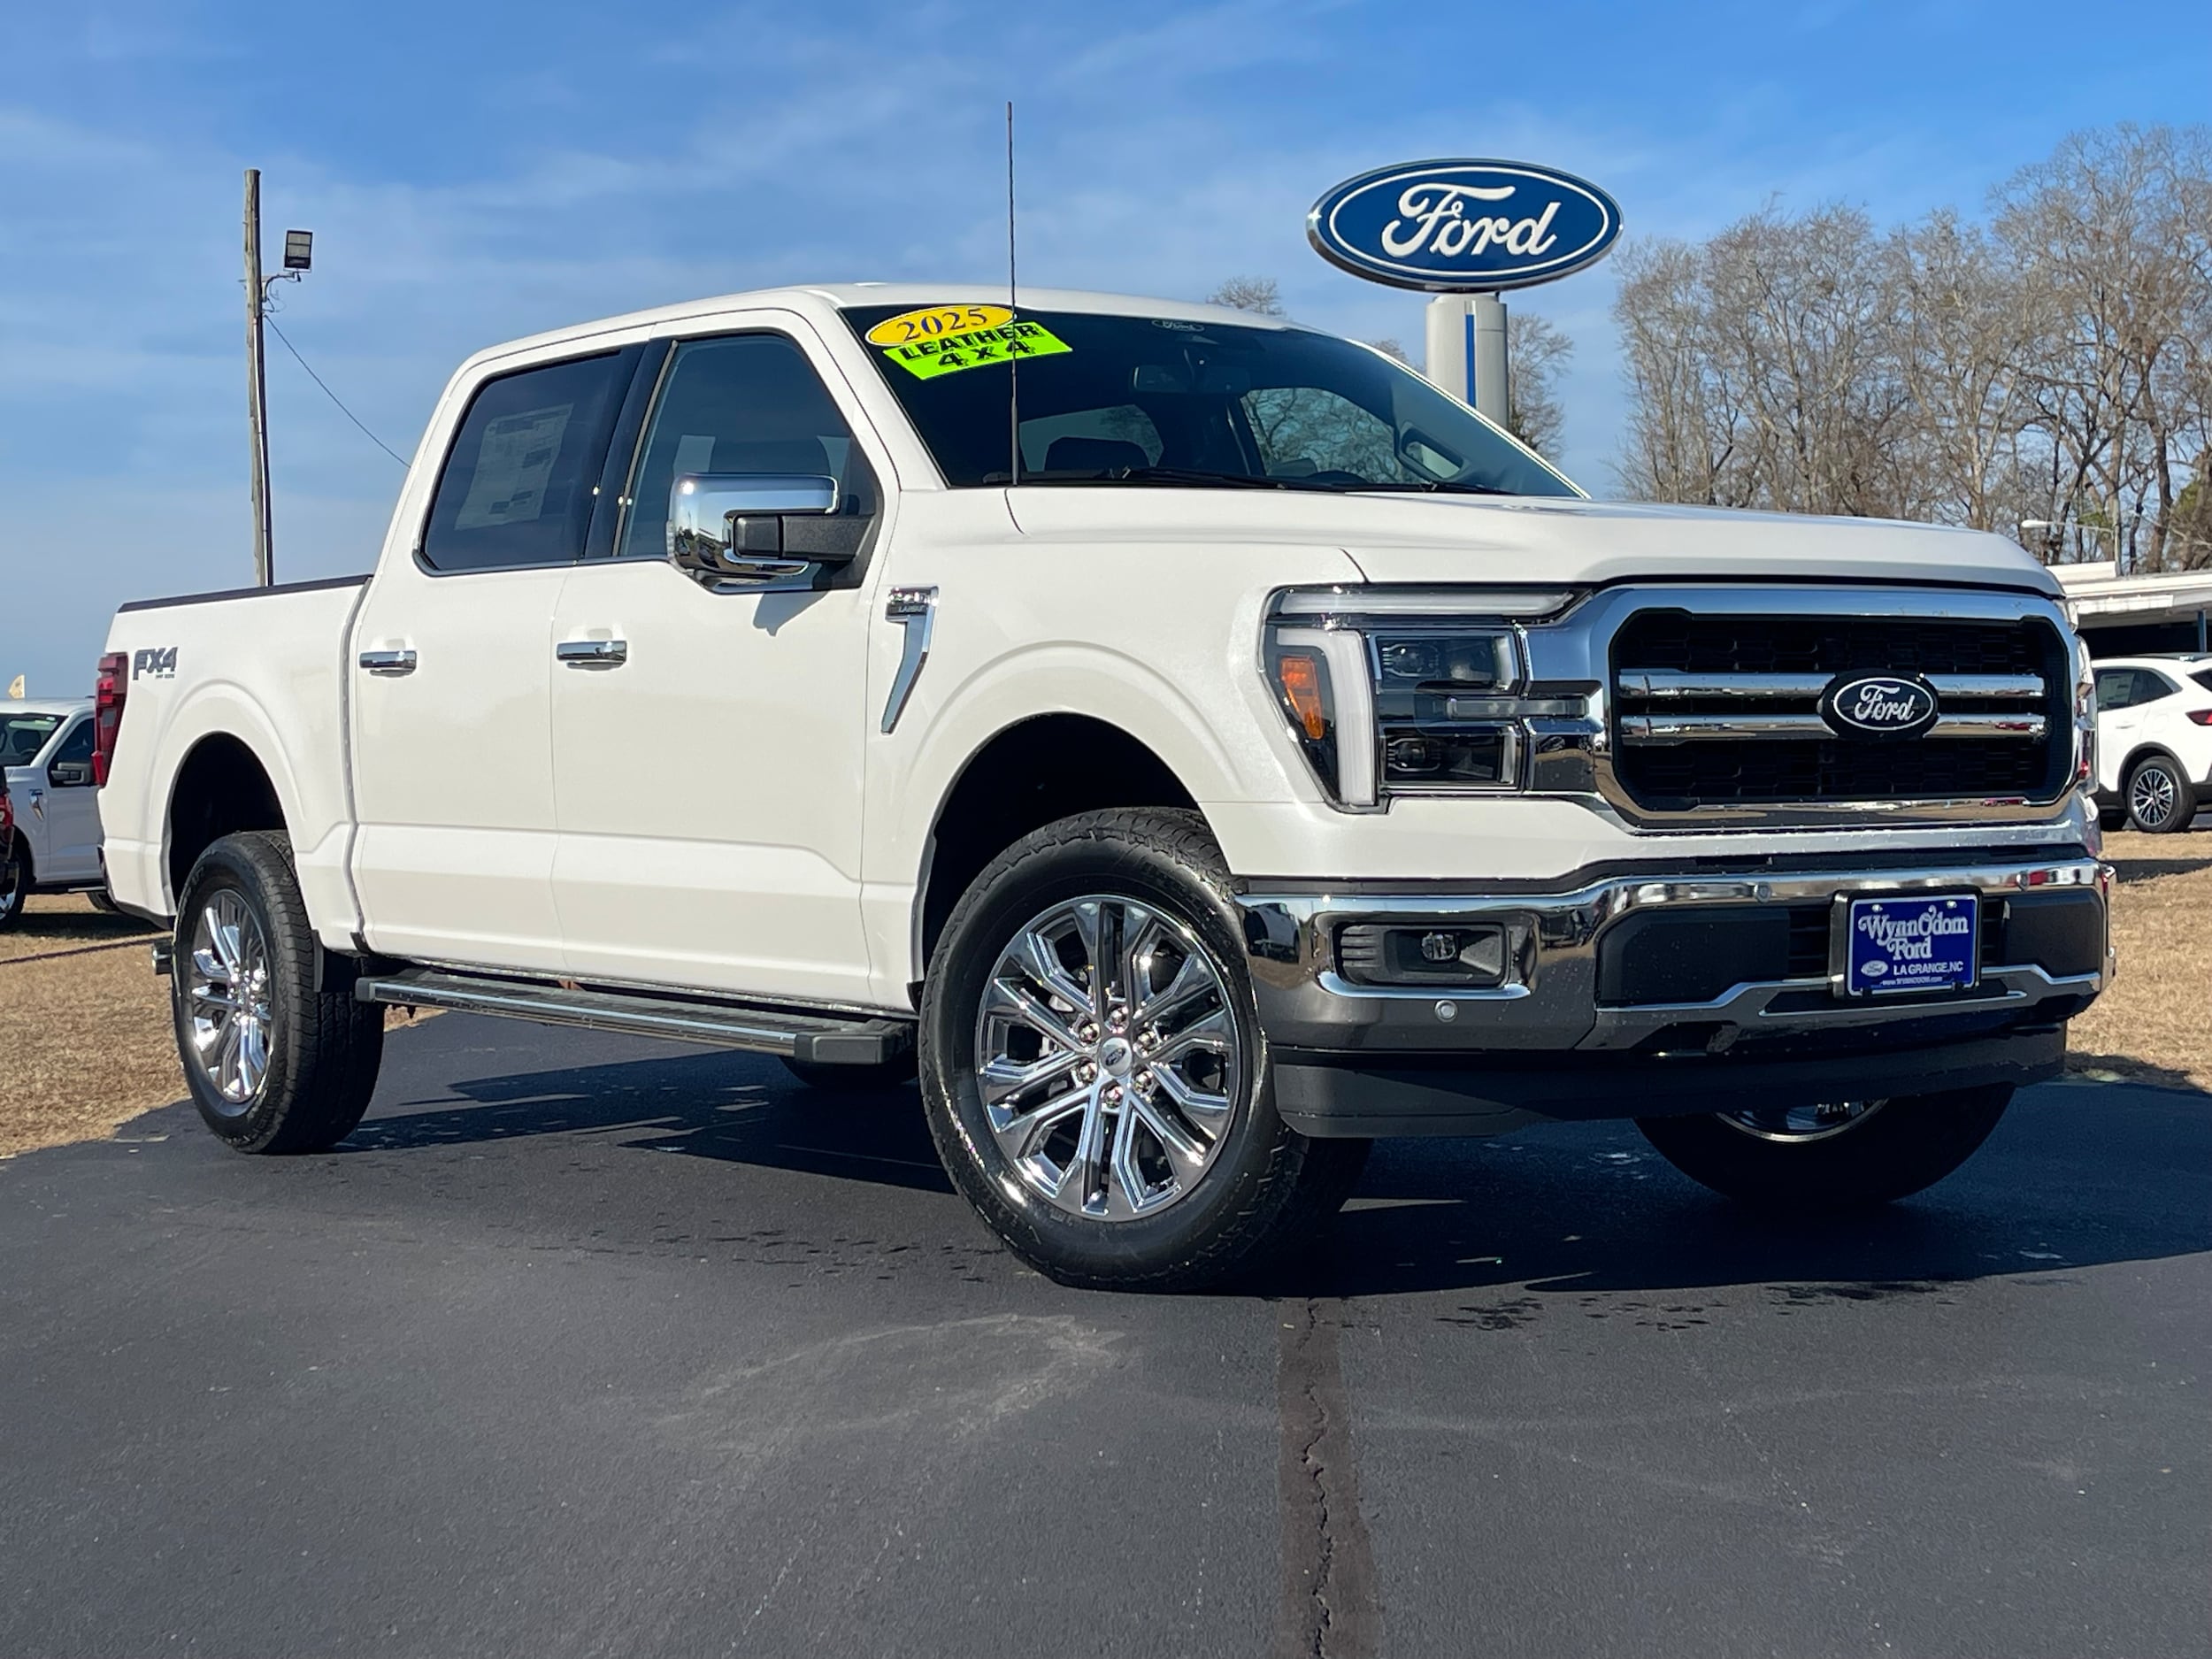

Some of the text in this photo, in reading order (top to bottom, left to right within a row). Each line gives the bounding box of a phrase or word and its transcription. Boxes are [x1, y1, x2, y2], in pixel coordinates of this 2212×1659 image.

[1381, 182, 1562, 257] Ford
[896, 308, 987, 342] 2025
[899, 322, 1041, 361] LEATHER
[133, 647, 178, 680] FX4
[1854, 684, 1916, 721] Ford
[1886, 935, 1932, 961] Ford
